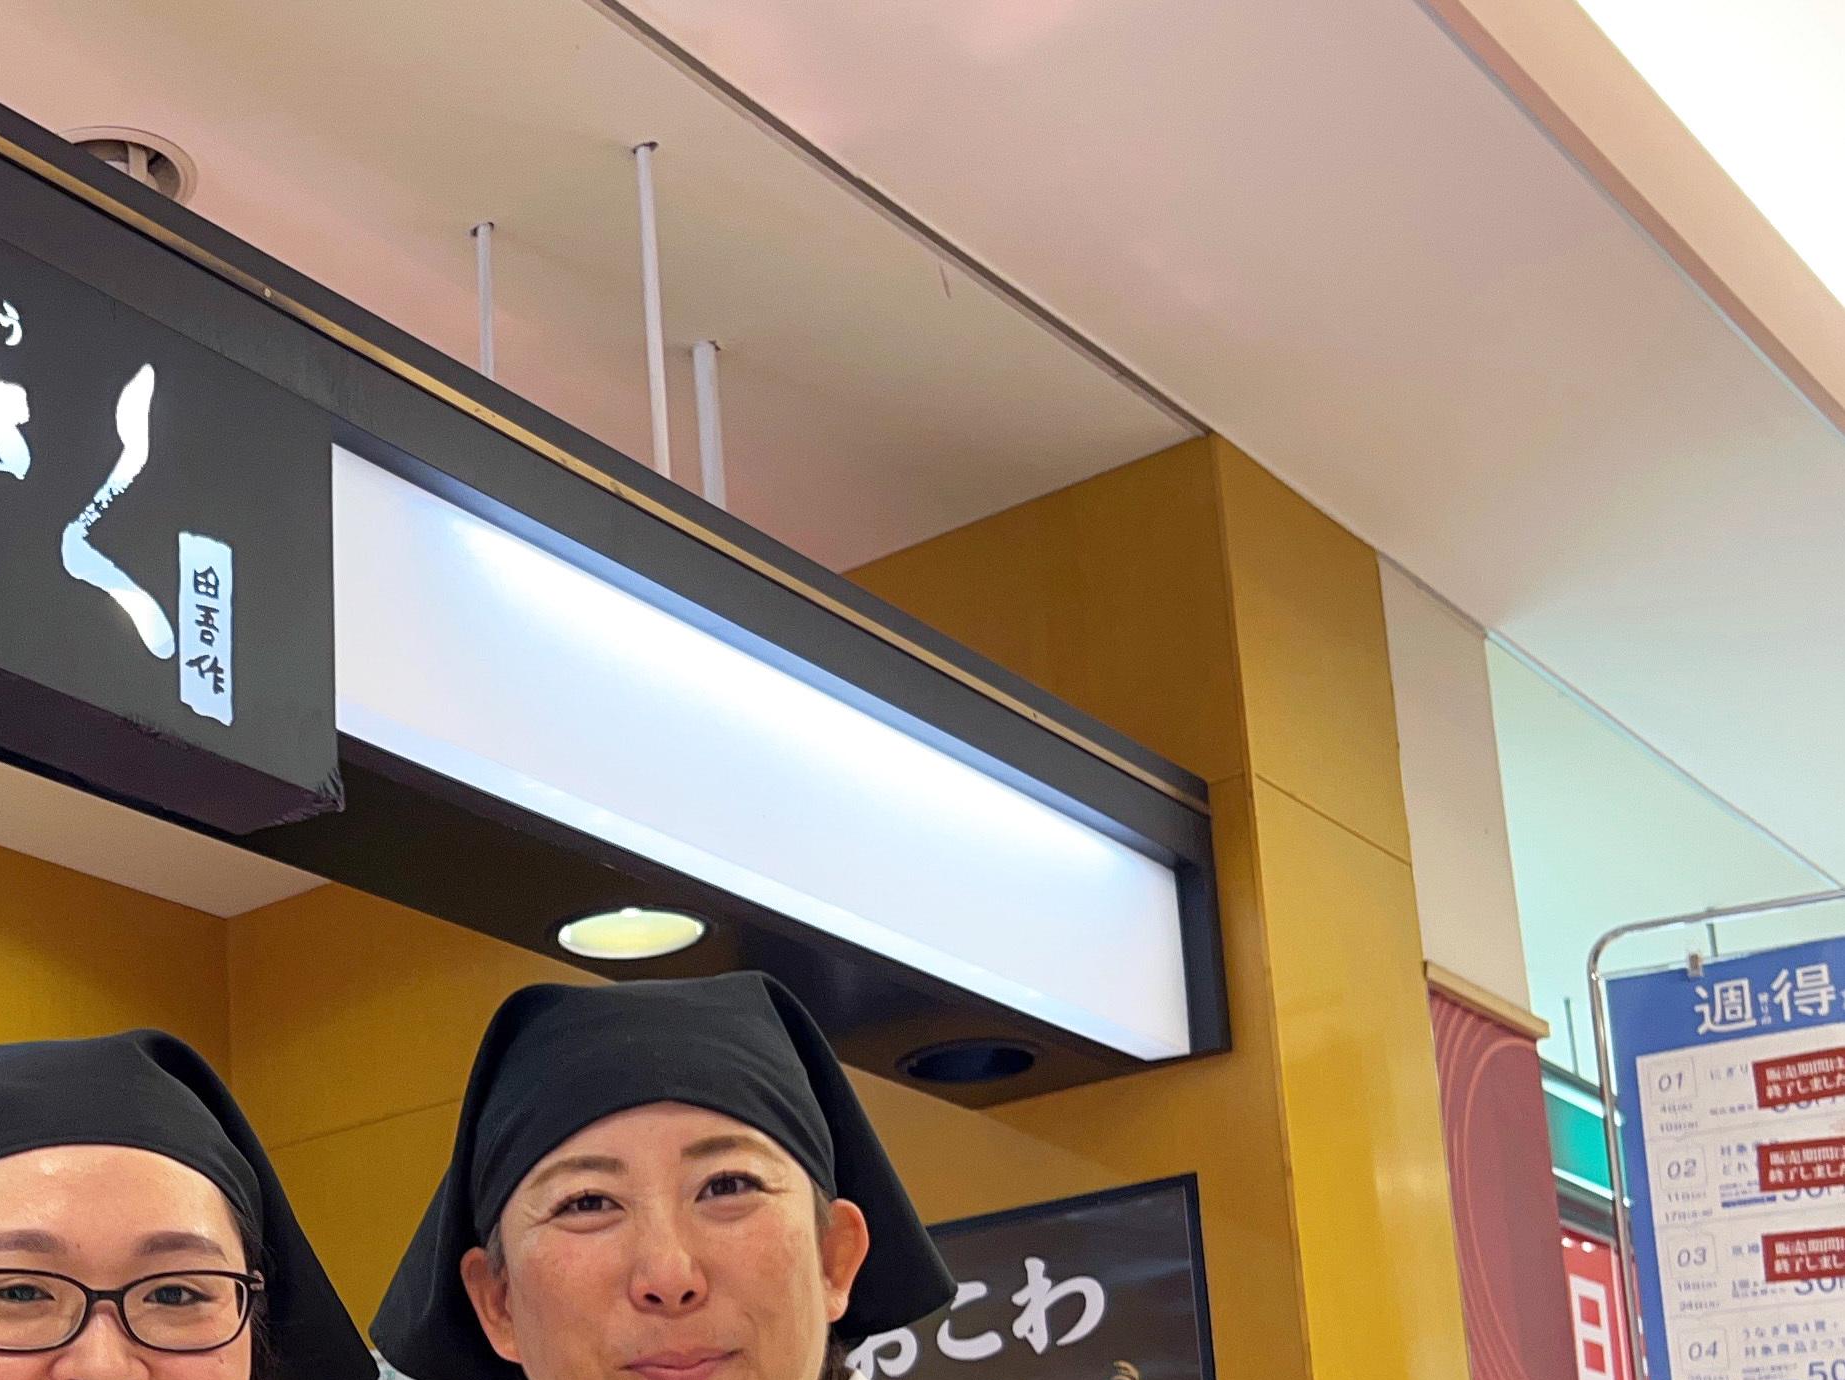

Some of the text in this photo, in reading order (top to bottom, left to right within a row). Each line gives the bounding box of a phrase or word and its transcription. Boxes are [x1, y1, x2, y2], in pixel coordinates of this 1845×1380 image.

[185, 565, 226, 697] 田吾作
[1658, 1073, 1684, 1091] 01
[1667, 1158, 1697, 1177] 02
[1677, 1248, 1707, 1267] 03
[1688, 1341, 1719, 1362] 04
